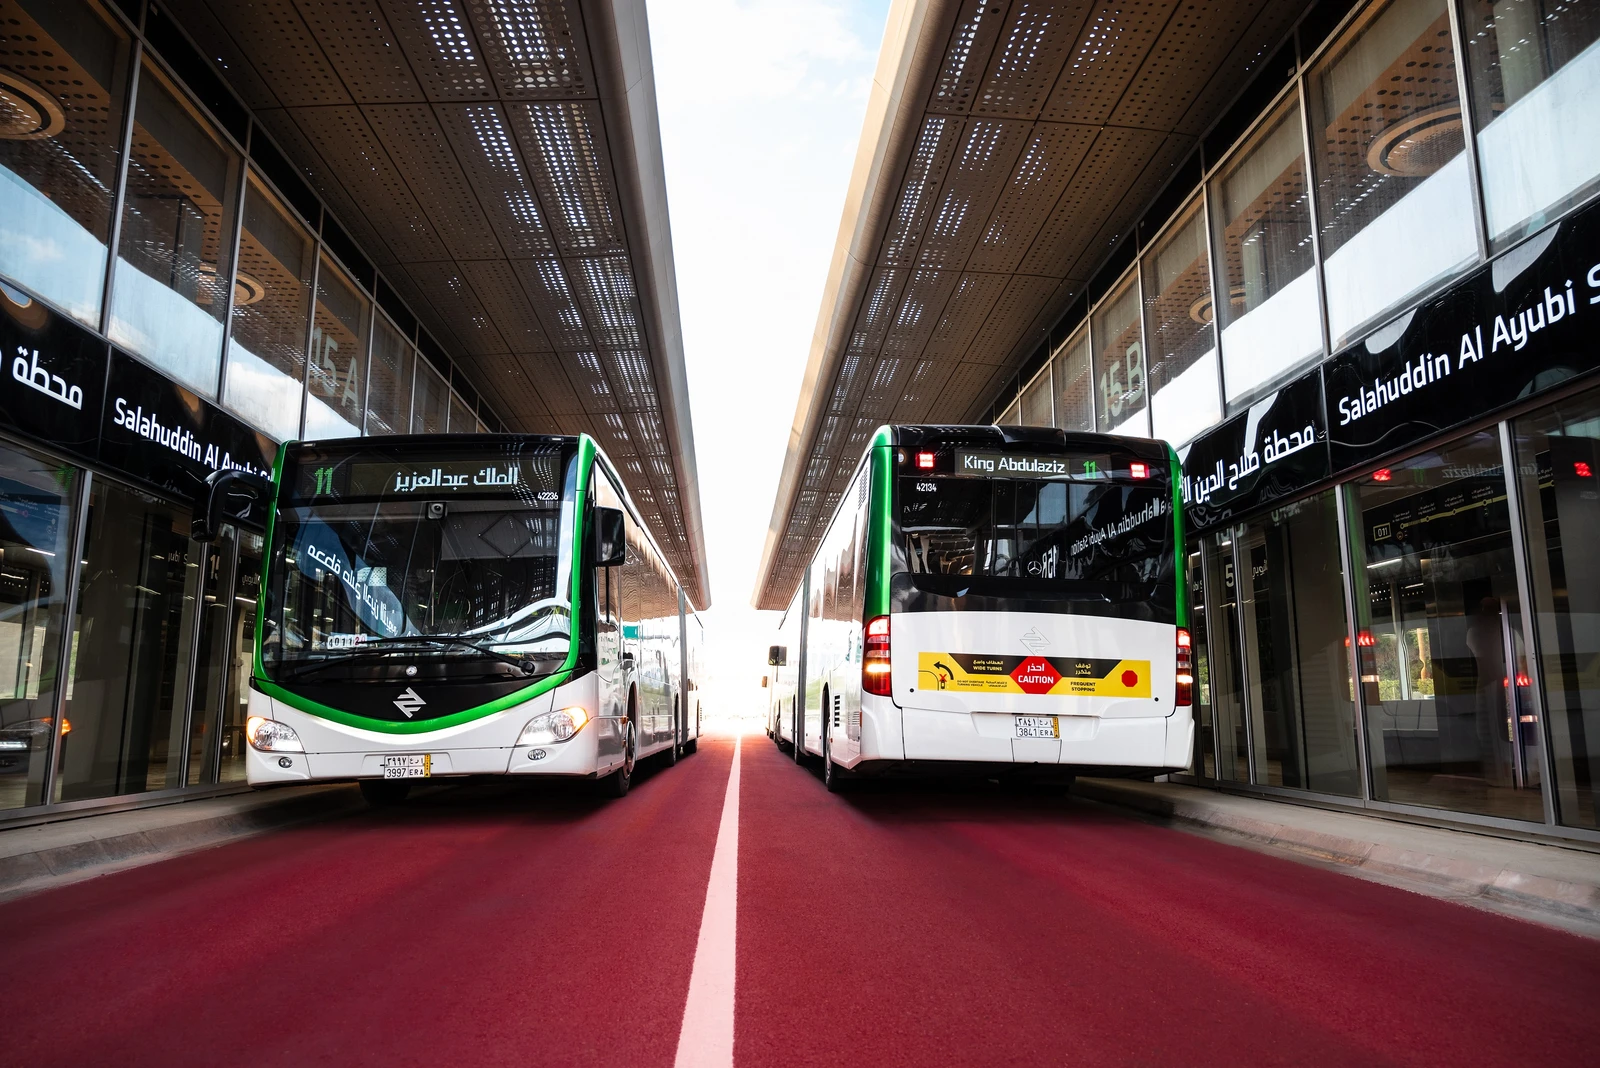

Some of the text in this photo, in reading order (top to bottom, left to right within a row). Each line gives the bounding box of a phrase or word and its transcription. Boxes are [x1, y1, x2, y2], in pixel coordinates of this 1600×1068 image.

[1338, 353, 1450, 425] Salahuddin
[1458, 325, 1484, 369] Al
[1491, 279, 1576, 351] Ayubi
[12, 345, 83, 411] محطة
[113, 397, 201, 462] Salahuddin
[203, 443, 220, 471] Al
[1264, 425, 1315, 464] محطة
[964, 455, 1065, 473] King Abdulaziz
[1083, 460, 1096, 479] 11
[1228, 446, 1260, 491] صلاح
[314, 467, 333, 495] 11
[394, 467, 519, 493] الملك عبدالعزيز
[916, 482, 937, 492] 42134
[1194, 458, 1225, 504] الدين
[537, 491, 559, 501] 42236
[1027, 663, 1045, 673] احذر
[1018, 675, 1054, 684] CAUTION
[1018, 727, 1037, 737] 3841
[386, 767, 407, 778] 3997
